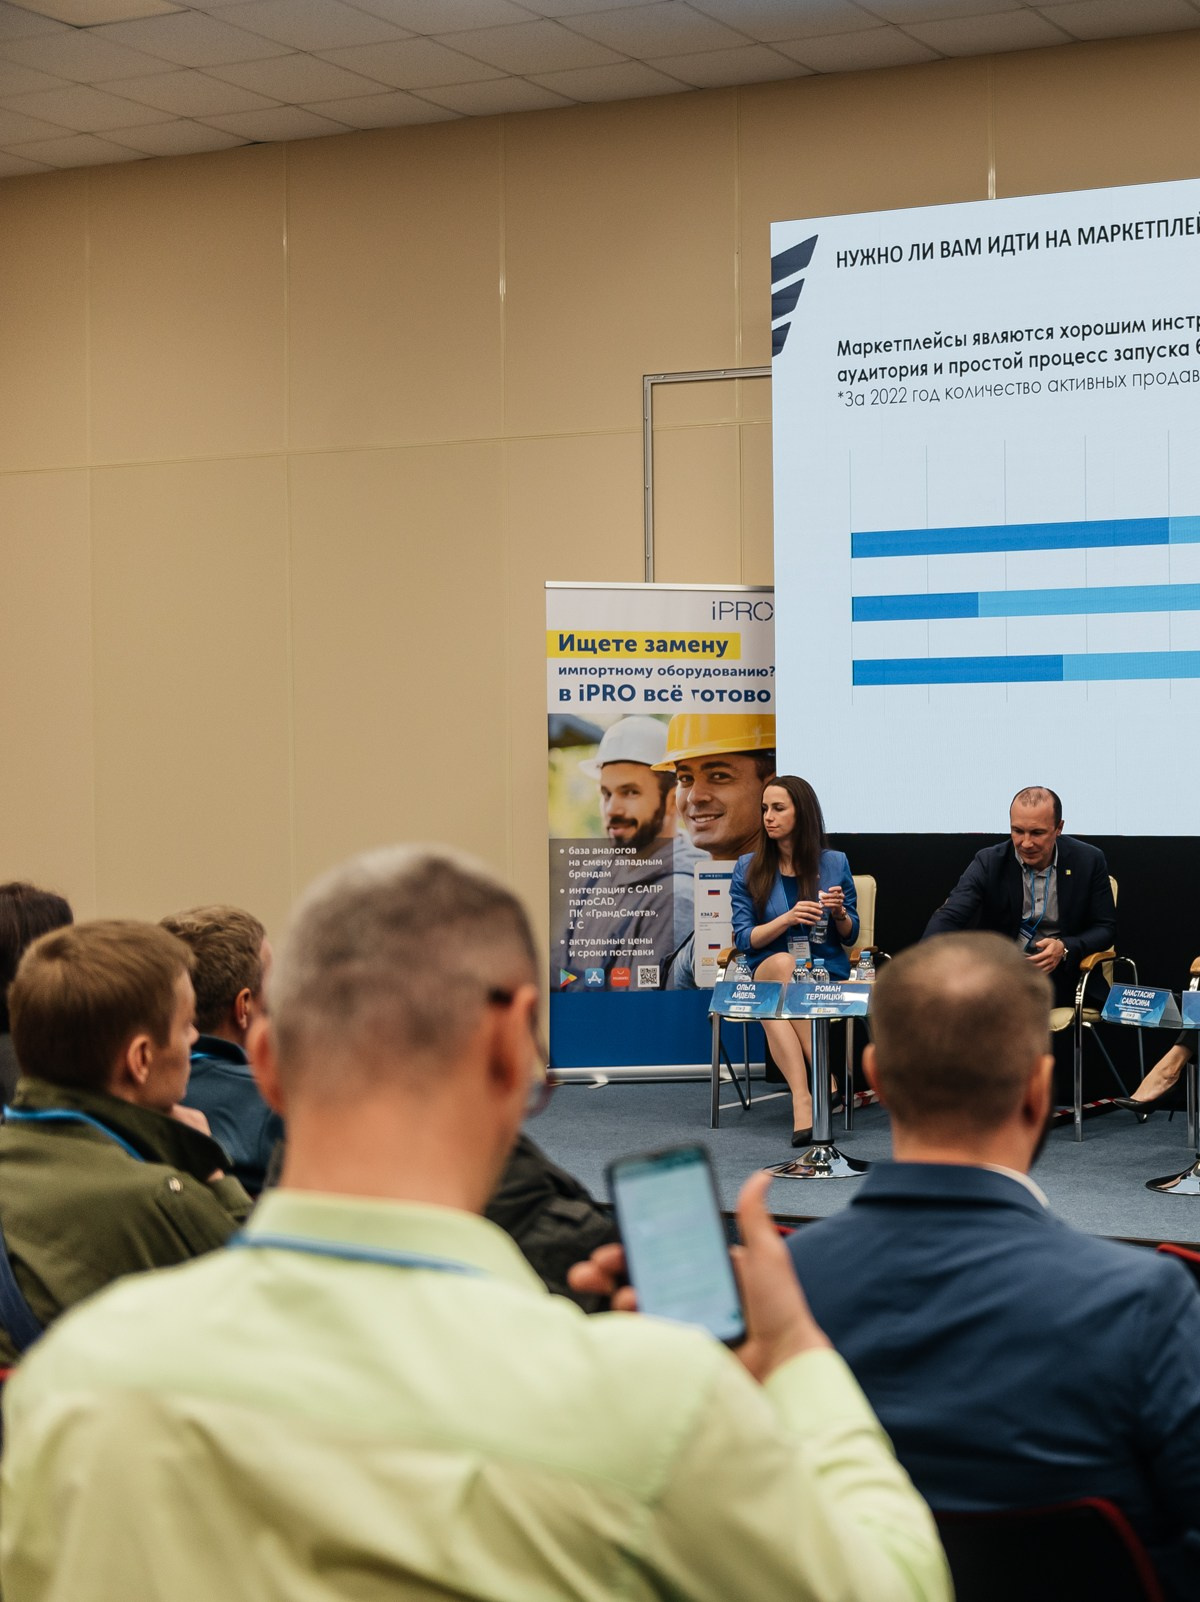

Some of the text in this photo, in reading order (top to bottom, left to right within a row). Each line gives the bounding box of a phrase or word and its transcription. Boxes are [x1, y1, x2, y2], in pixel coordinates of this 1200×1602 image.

[836, 245, 904, 268] НУЖНО
[908, 241, 934, 261] ЛИ
[940, 237, 982, 259] ВАМ
[988, 232, 1040, 257] ИДТИ
[1046, 228, 1072, 249] НА
[837, 328, 968, 358] Маркетплейсы
[972, 326, 1054, 348] являются
[1059, 317, 1147, 342] хорошим
[837, 360, 929, 386] аудитория
[933, 361, 944, 375] и
[948, 350, 1024, 379] простой
[1029, 346, 1108, 372] процесс
[1114, 340, 1190, 366] запуска
[870, 386, 907, 406] 2022
[912, 386, 941, 405] год
[945, 378, 1042, 399] количество
[1047, 372, 1127, 393] активных
[712, 600, 774, 621] iPRO
[558, 633, 729, 658] Ищете замену
[558, 664, 776, 678] импортному оборудованию?
[559, 688, 571, 701] в
[579, 684, 636, 702] iPRO
[644, 684, 683, 702] всё
[569, 846, 637, 855] база аналогов
[569, 858, 663, 869] на смену западным
[569, 870, 612, 880] брендам
[569, 886, 626, 896] интеграция
[635, 884, 663, 894] САПР
[569, 898, 616, 907] nanoCAD,
[569, 908, 584, 918] ПК
[569, 936, 653, 947] актуальные цены
[577, 950, 608, 959] сроки
[609, 948, 655, 957] поставки
[736, 983, 756, 991] ОЛЬГА
[814, 985, 841, 993] РОМАН
[805, 993, 846, 1002] ТЕРЛИЦКИ
